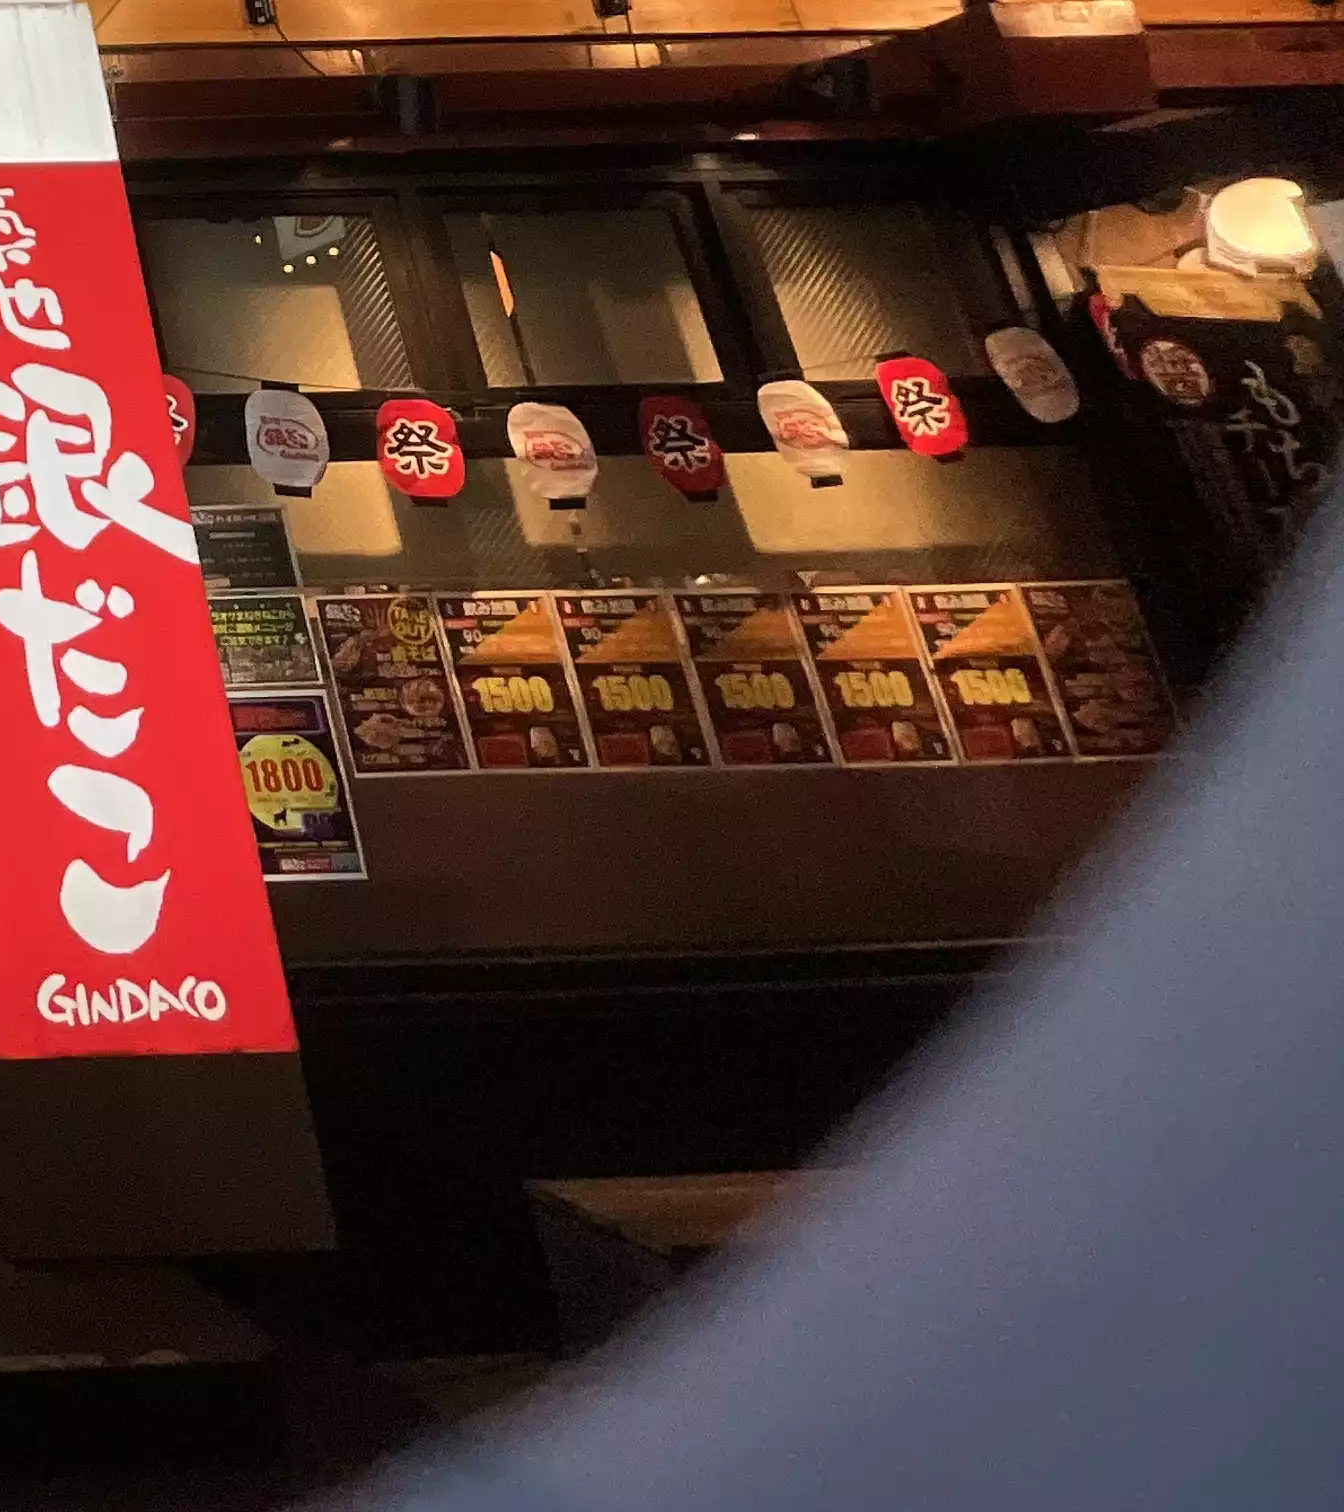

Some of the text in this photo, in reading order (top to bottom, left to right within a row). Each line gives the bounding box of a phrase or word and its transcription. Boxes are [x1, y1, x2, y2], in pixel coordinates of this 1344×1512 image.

[890, 377, 952, 438] 祭
[388, 418, 451, 478] 祭
[649, 414, 711, 474] 祭
[473, 675, 555, 713] 1500
[245, 757, 325, 793] 1800
[36, 971, 227, 1028] GINDACO
